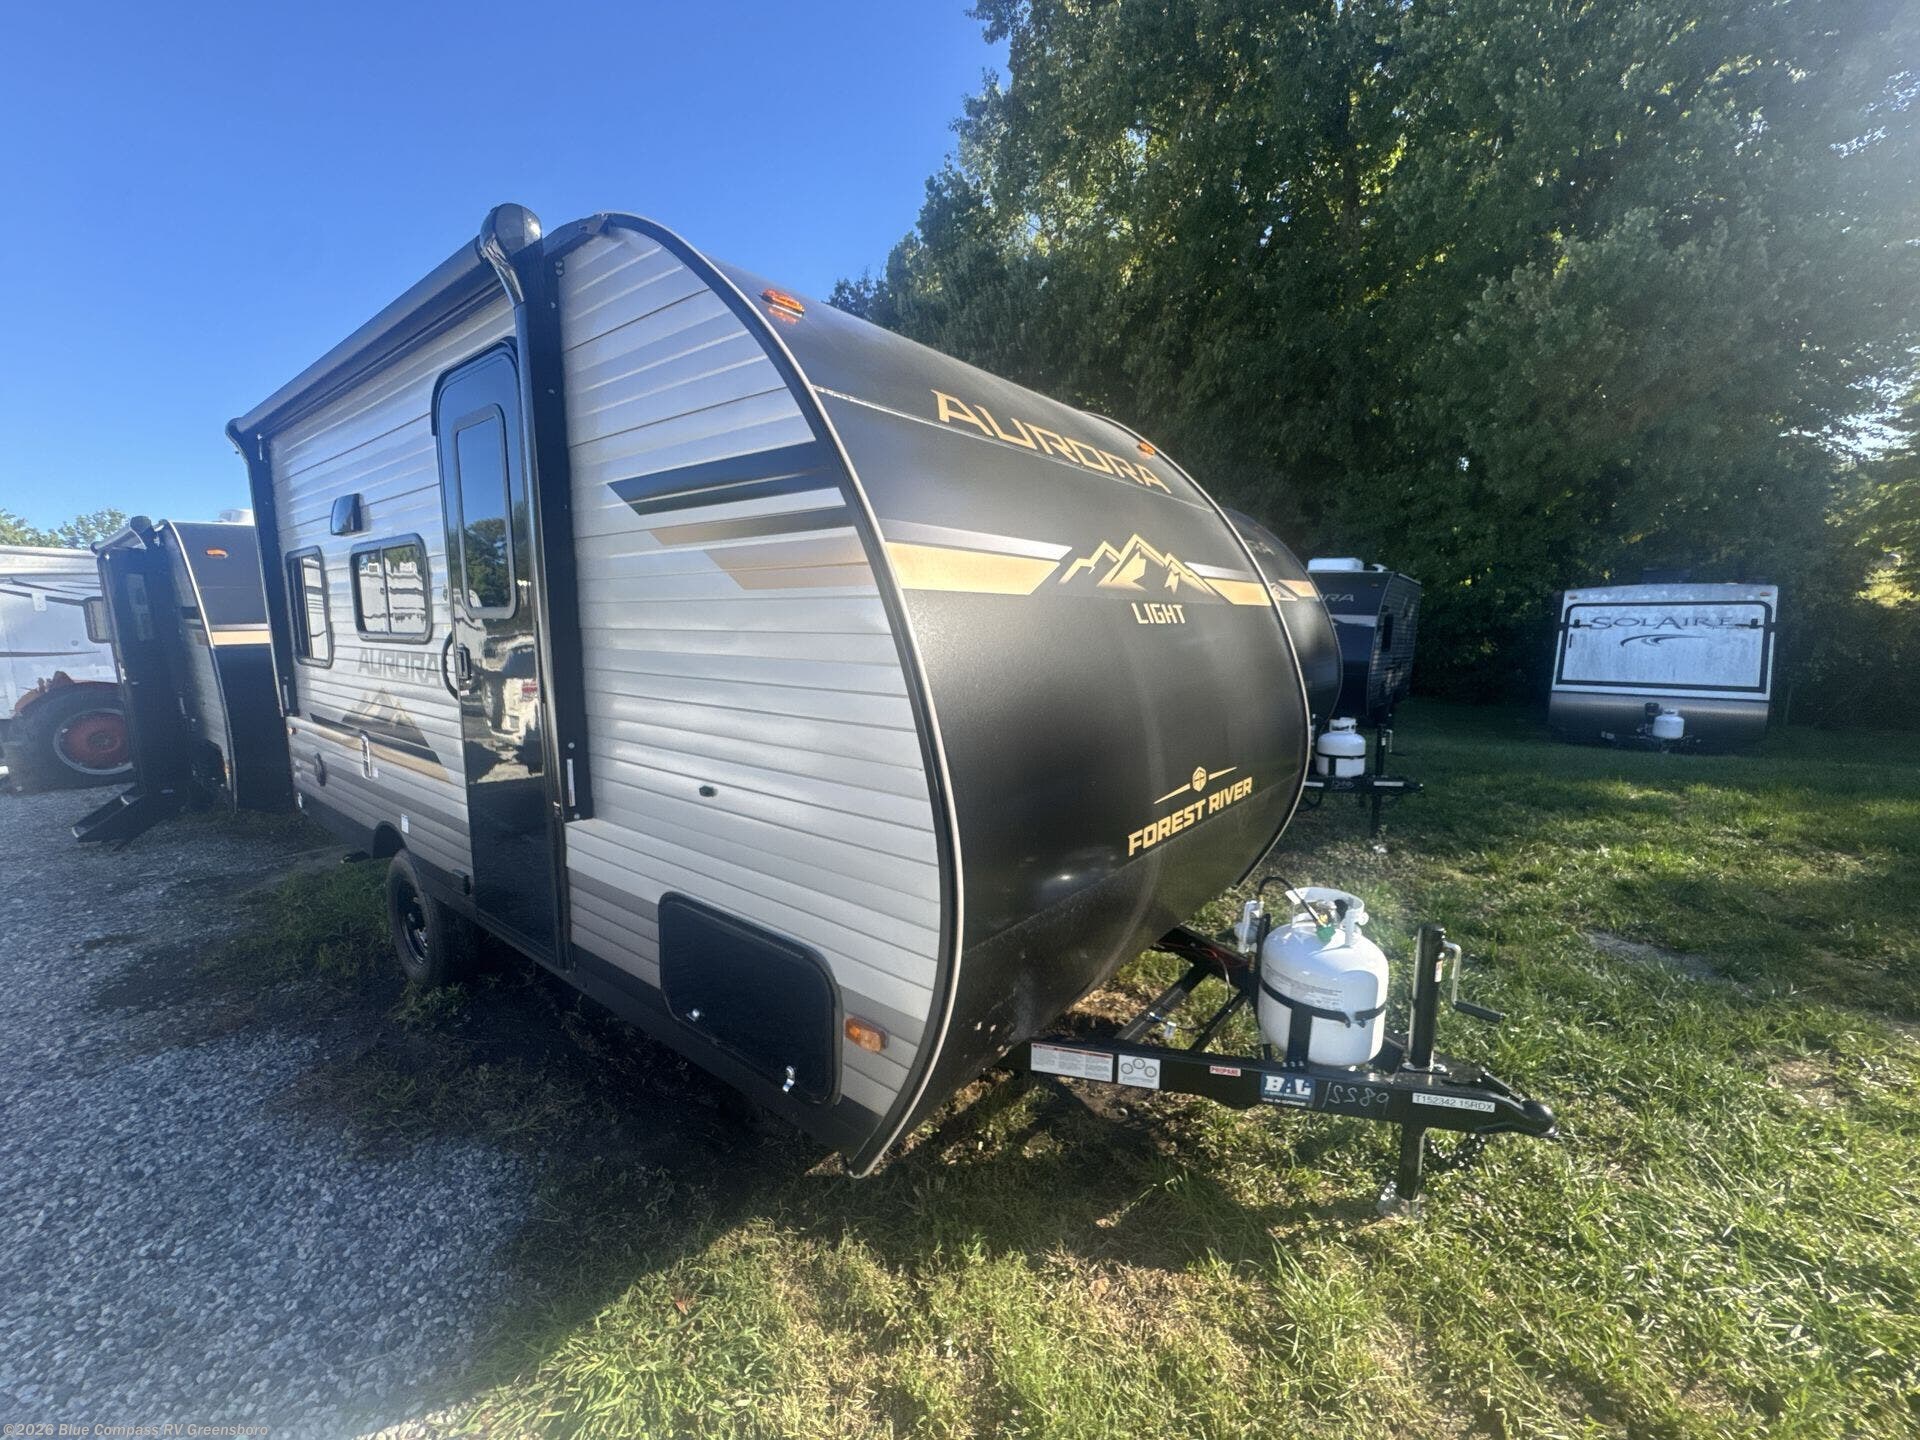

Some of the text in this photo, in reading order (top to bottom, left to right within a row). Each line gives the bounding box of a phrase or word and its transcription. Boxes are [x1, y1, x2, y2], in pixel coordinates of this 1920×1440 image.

[931, 389, 1172, 494] AURORA
[1131, 602, 1186, 625] LIGHT
[1590, 616, 1733, 630] SOLAIRE
[357, 648, 442, 686] AURORA
[1128, 776, 1253, 857] FOREST RIVER
[1459, 1100, 1493, 1112] 15RDX
